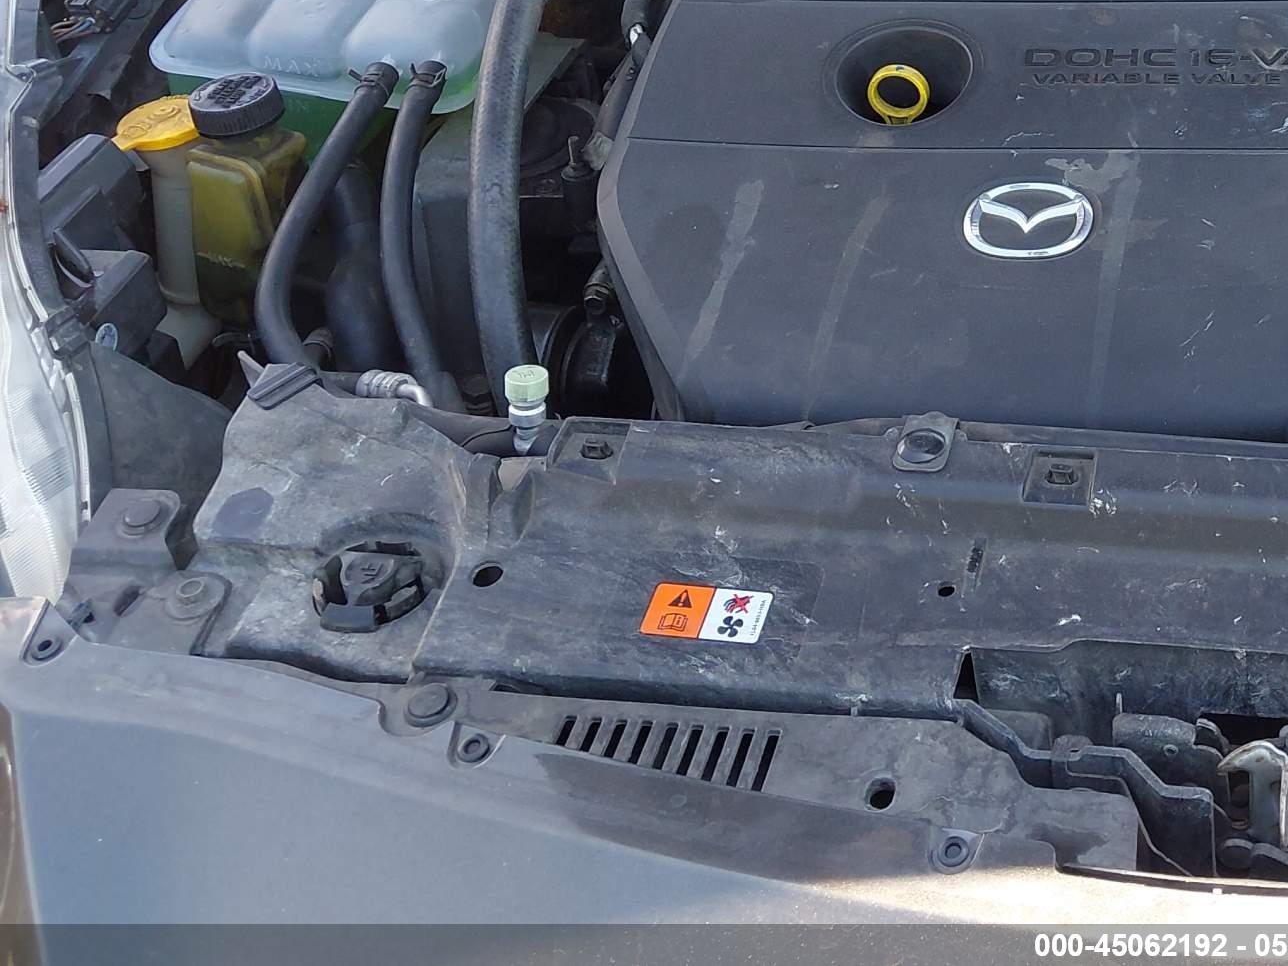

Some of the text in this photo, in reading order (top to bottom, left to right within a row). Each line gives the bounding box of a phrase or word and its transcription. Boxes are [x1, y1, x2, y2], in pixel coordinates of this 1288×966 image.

[263, 55, 321, 77] MAX
[1024, 48, 1177, 67] DOHC
[1033, 73, 1181, 86] VARIABLE
[1191, 73, 1281, 86] VALVE
